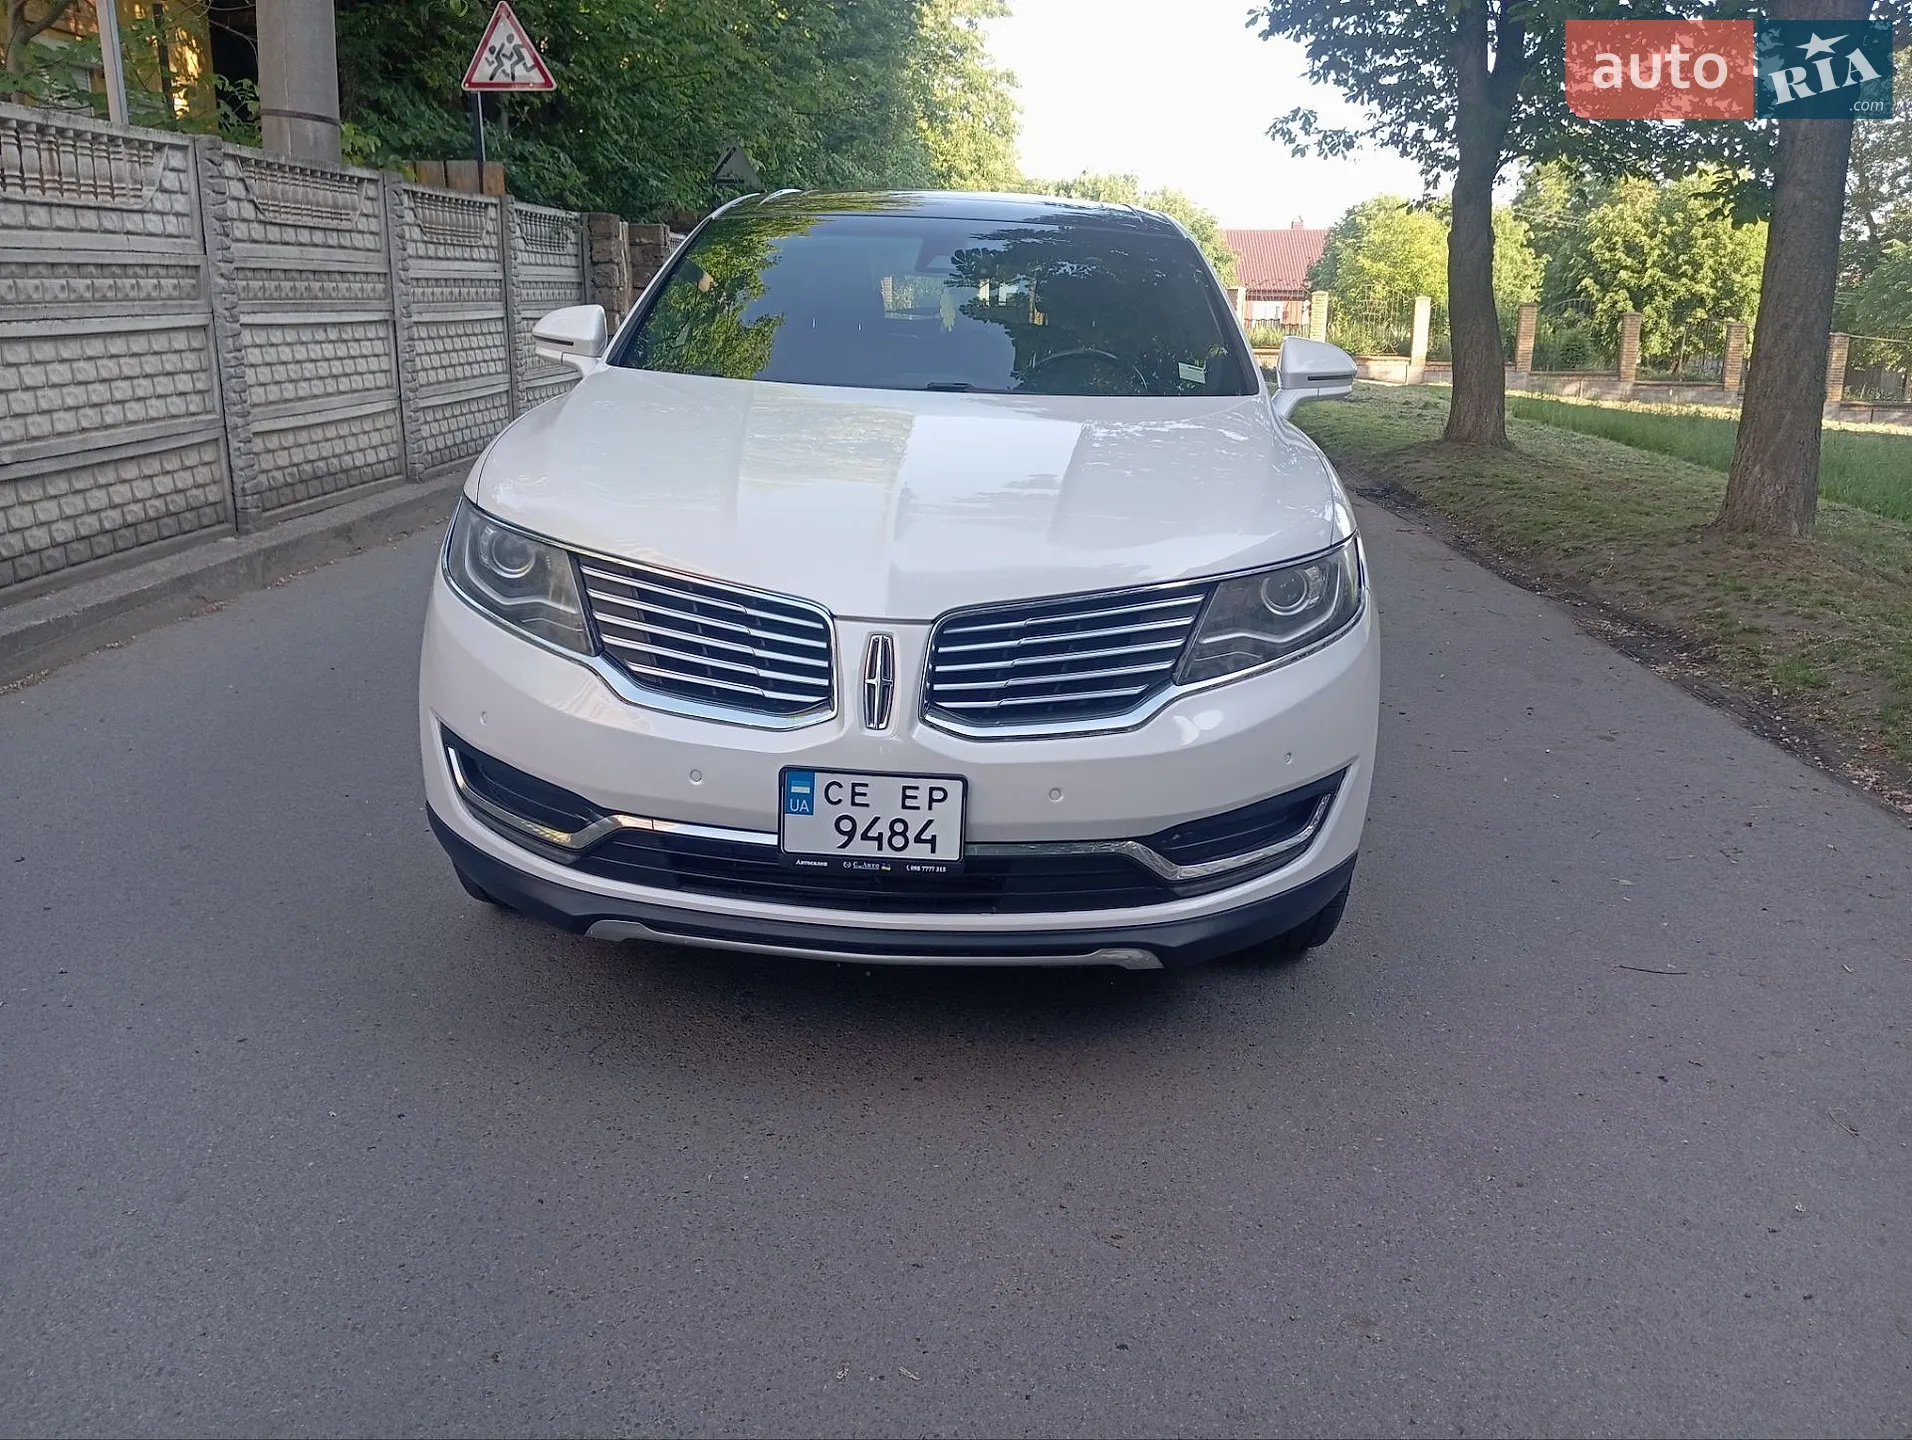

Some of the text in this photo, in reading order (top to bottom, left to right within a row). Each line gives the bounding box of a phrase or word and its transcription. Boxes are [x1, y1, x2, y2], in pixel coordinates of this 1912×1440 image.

[789, 799, 810, 813] UA
[824, 780, 948, 811] CE EP
[834, 813, 937, 854] 9484
